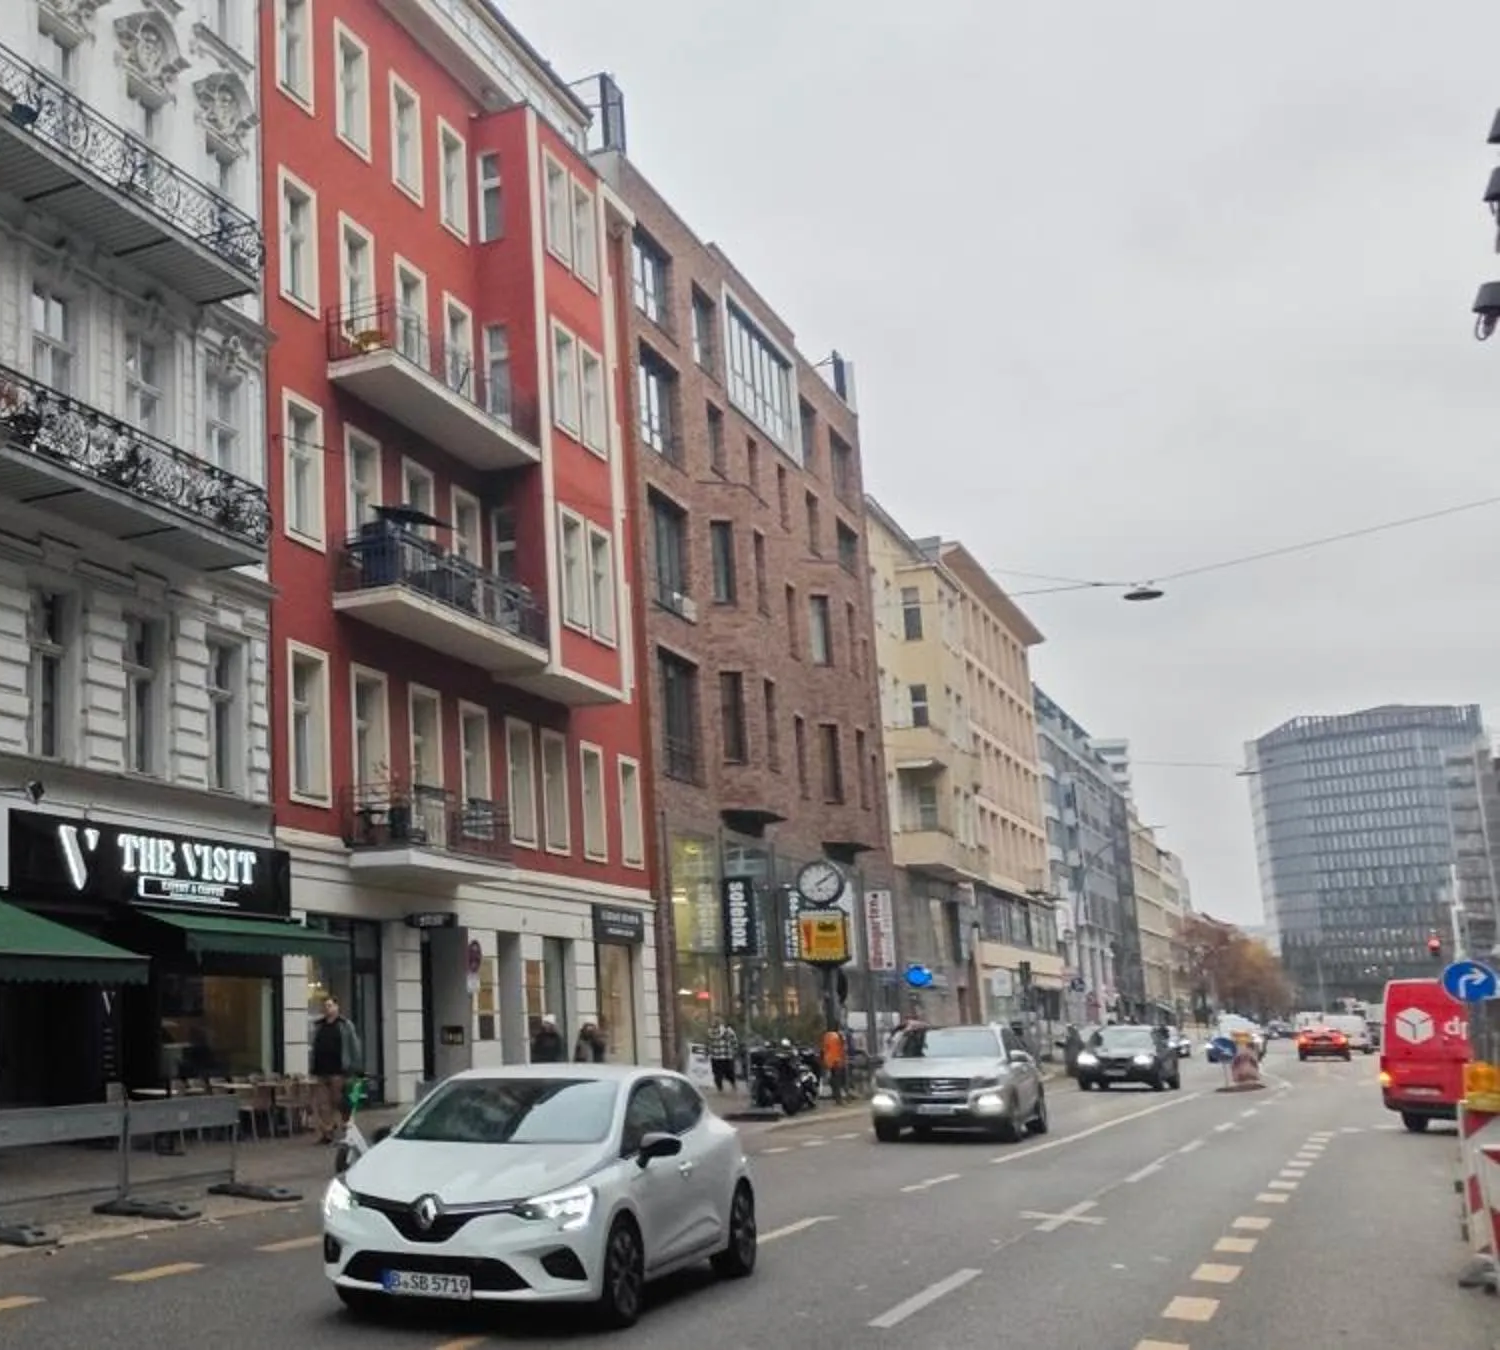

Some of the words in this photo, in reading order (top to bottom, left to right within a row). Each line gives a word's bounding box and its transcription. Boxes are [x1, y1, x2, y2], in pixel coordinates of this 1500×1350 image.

[117, 833, 177, 876] THE
[181, 842, 257, 885] VISIT
[431, 1276, 469, 1293] 5719
